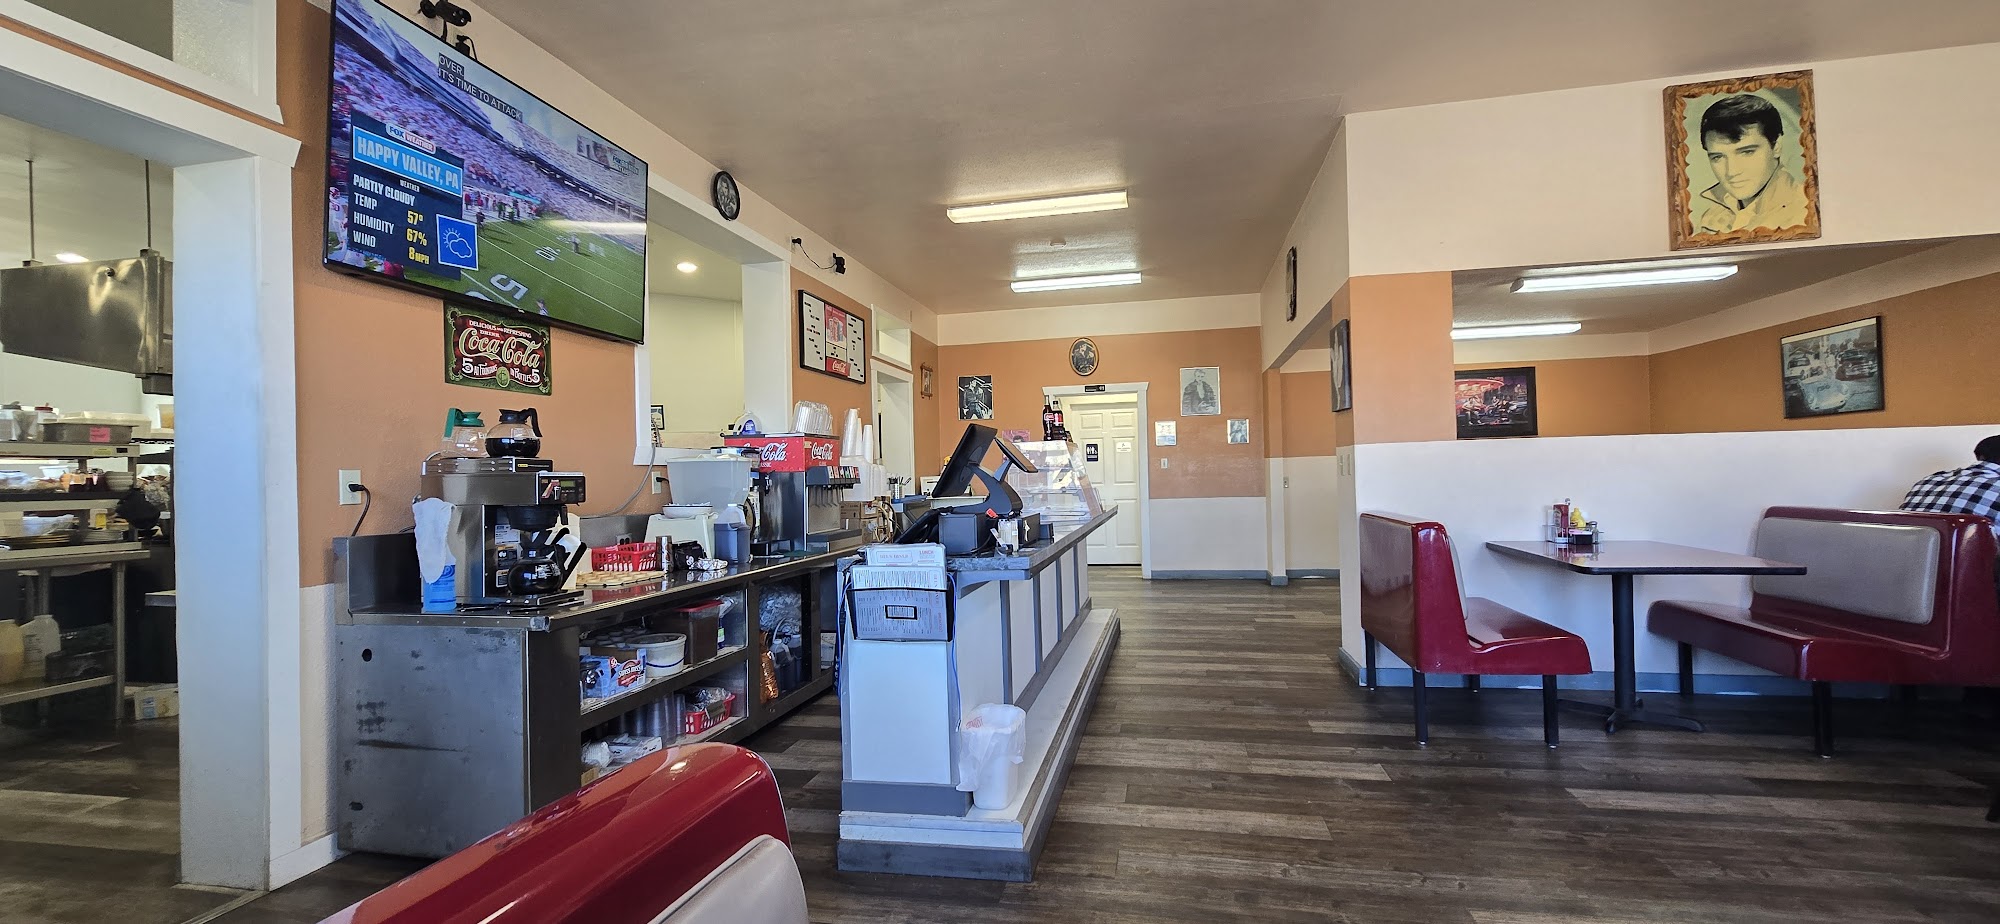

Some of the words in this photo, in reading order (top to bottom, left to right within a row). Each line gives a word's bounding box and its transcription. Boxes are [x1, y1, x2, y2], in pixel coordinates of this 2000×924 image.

[439, 55, 464, 76] OVER.
[438, 68, 454, 83] IT'S
[456, 77, 477, 96] TIME
[478, 89, 490, 102] TO
[491, 99, 521, 120] ATTACK
[389, 126, 405, 138] FOX
[406, 132, 433, 151] WEATHER
[357, 136, 399, 167] HAPPY
[402, 152, 443, 185] VALLEY,
[445, 170, 459, 189] PA
[353, 173, 384, 196] PARTLY
[384, 185, 416, 207] CLOUDY
[399, 179, 420, 193] WEATHER
[354, 192, 378, 211] TEMP
[353, 211, 395, 235] HUMIDITY
[406, 228, 427, 247] 67%
[353, 230, 376, 248] WIND
[469, 319, 497, 331] DELICIOUS
[459, 327, 541, 369] Coca-Cola
[811, 441, 833, 460] Coca-Cola
